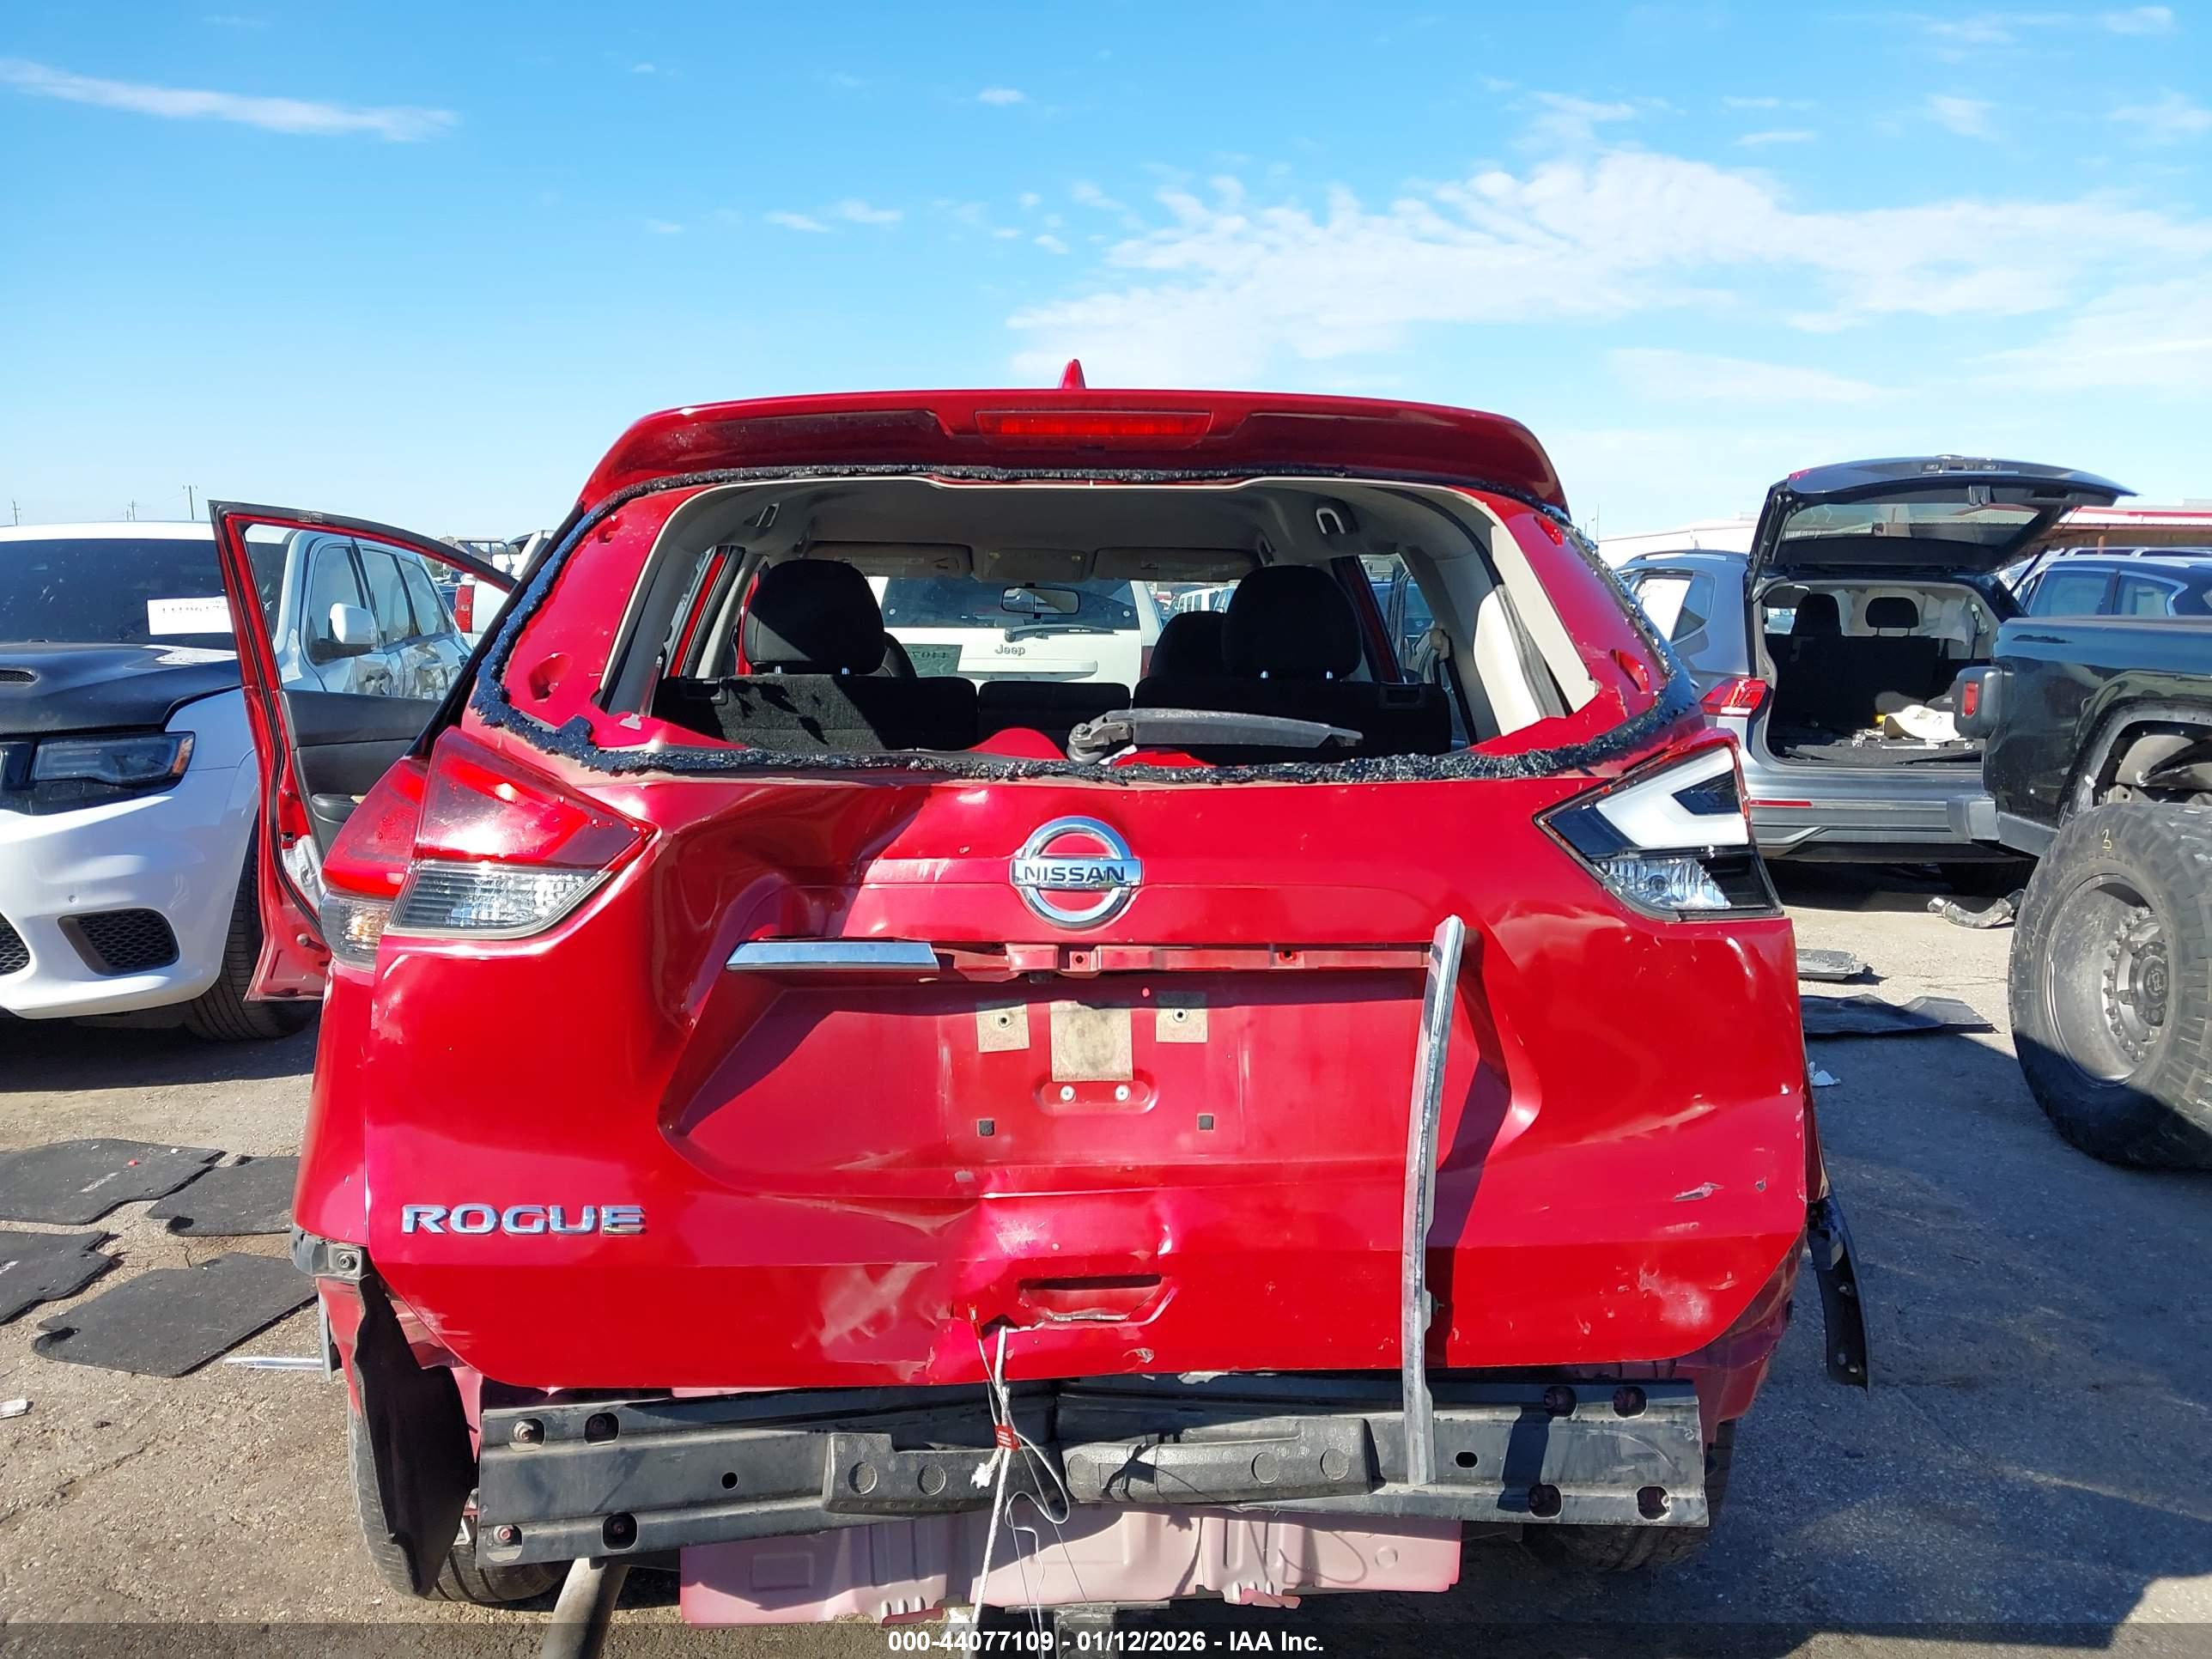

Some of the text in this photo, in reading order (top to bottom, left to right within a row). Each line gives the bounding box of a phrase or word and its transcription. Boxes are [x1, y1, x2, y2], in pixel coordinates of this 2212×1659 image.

[994, 644, 1026, 656] Jeep
[1024, 866, 1125, 883] NISSAN
[401, 1203, 647, 1235] ROGUE
